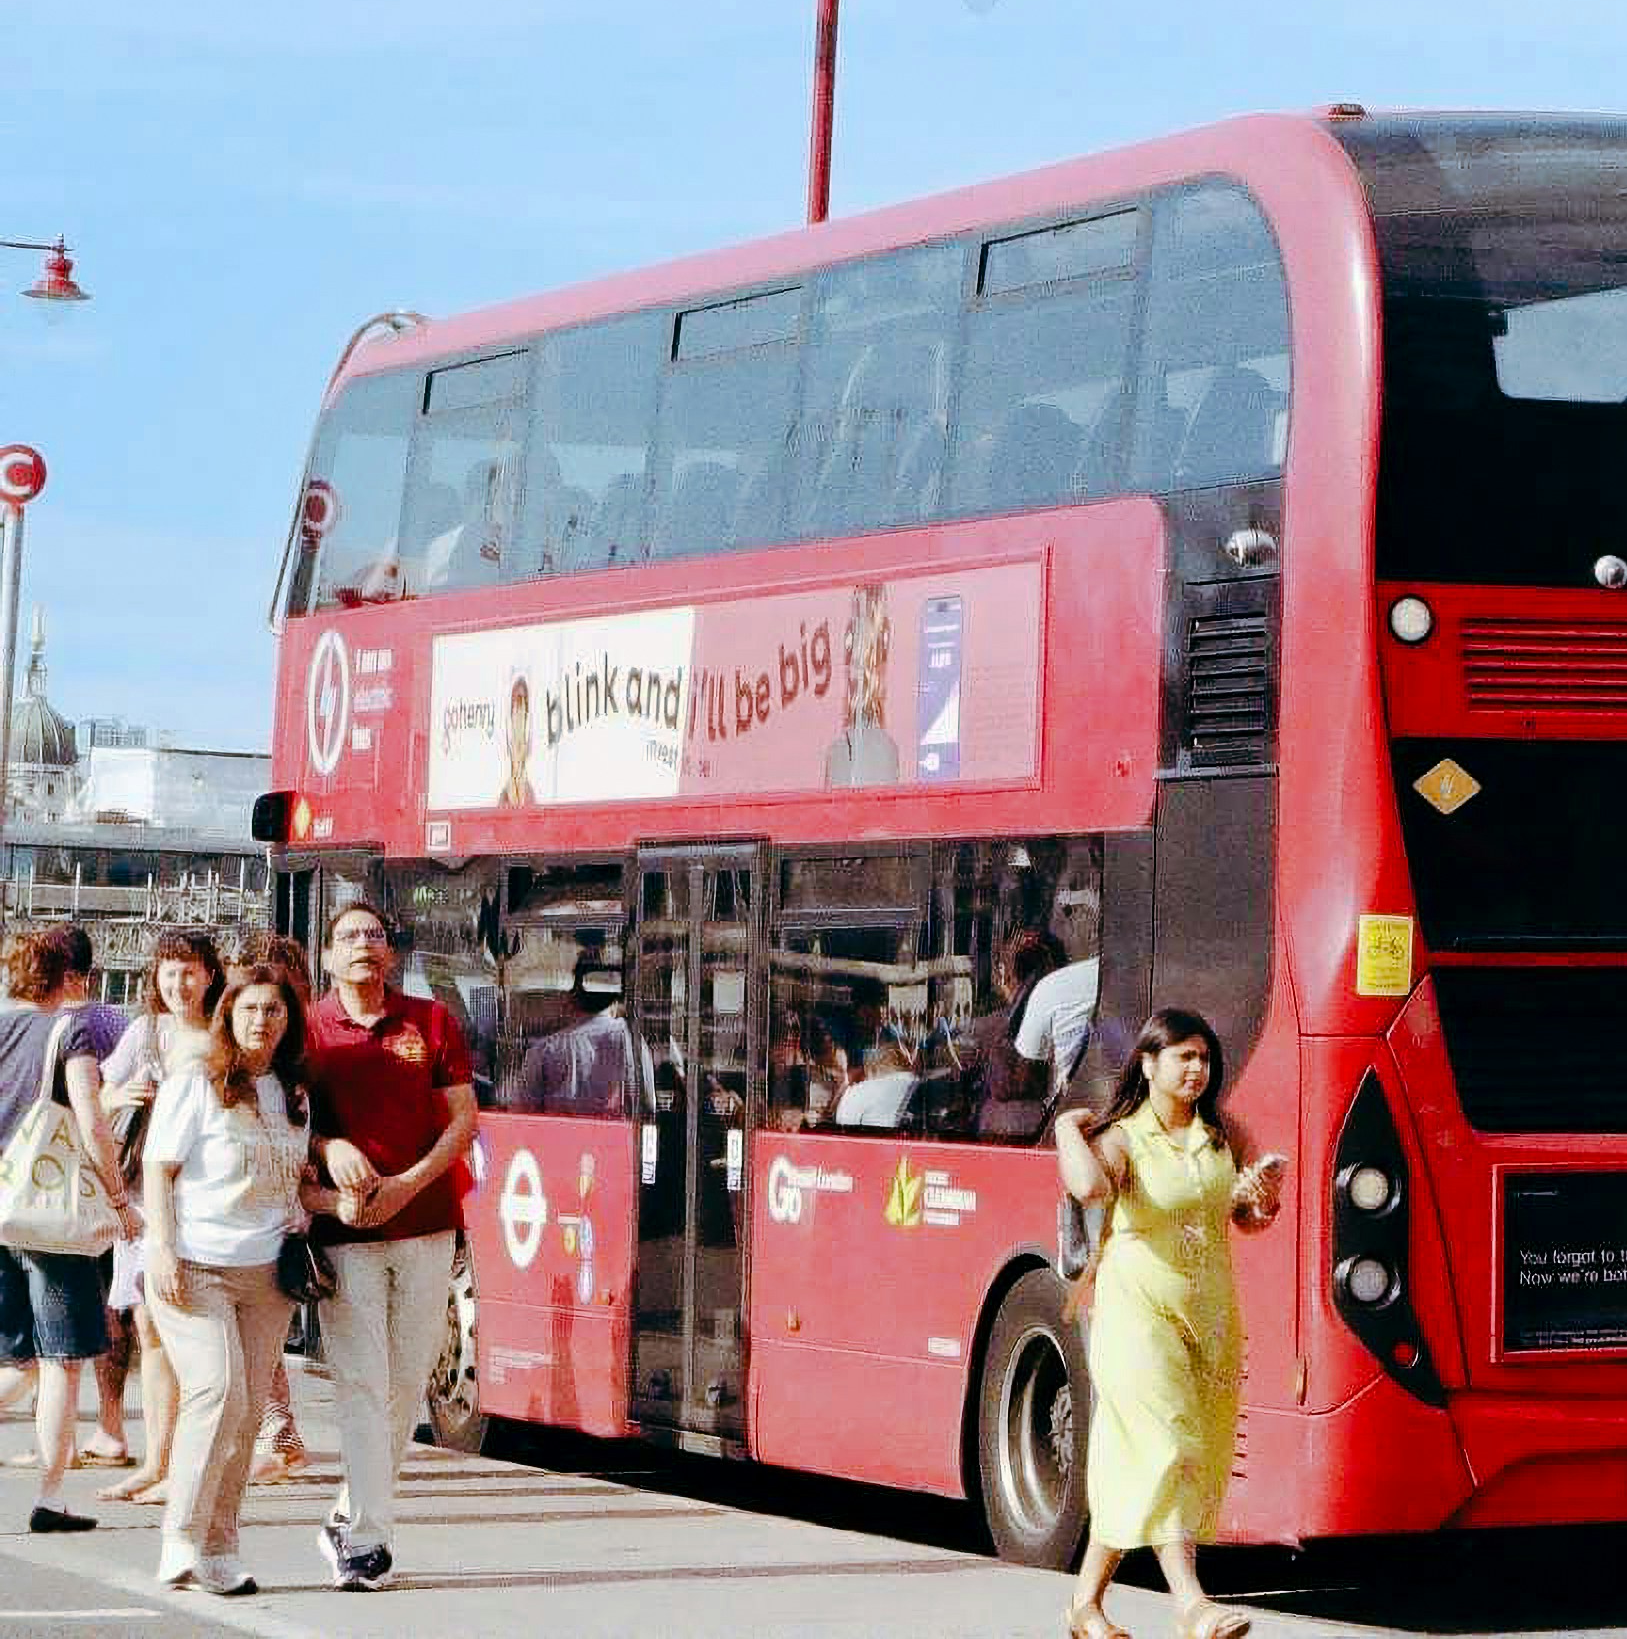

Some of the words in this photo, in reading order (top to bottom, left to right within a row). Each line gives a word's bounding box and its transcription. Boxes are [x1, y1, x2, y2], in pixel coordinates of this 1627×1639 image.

[546, 650, 620, 745] blink
[626, 666, 683, 730] and
[735, 667, 771, 738] be
[779, 618, 833, 711] big
[1519, 1249, 1548, 1265] You
[1601, 1248, 1615, 1263] to
[1519, 1270, 1553, 1285] Now
